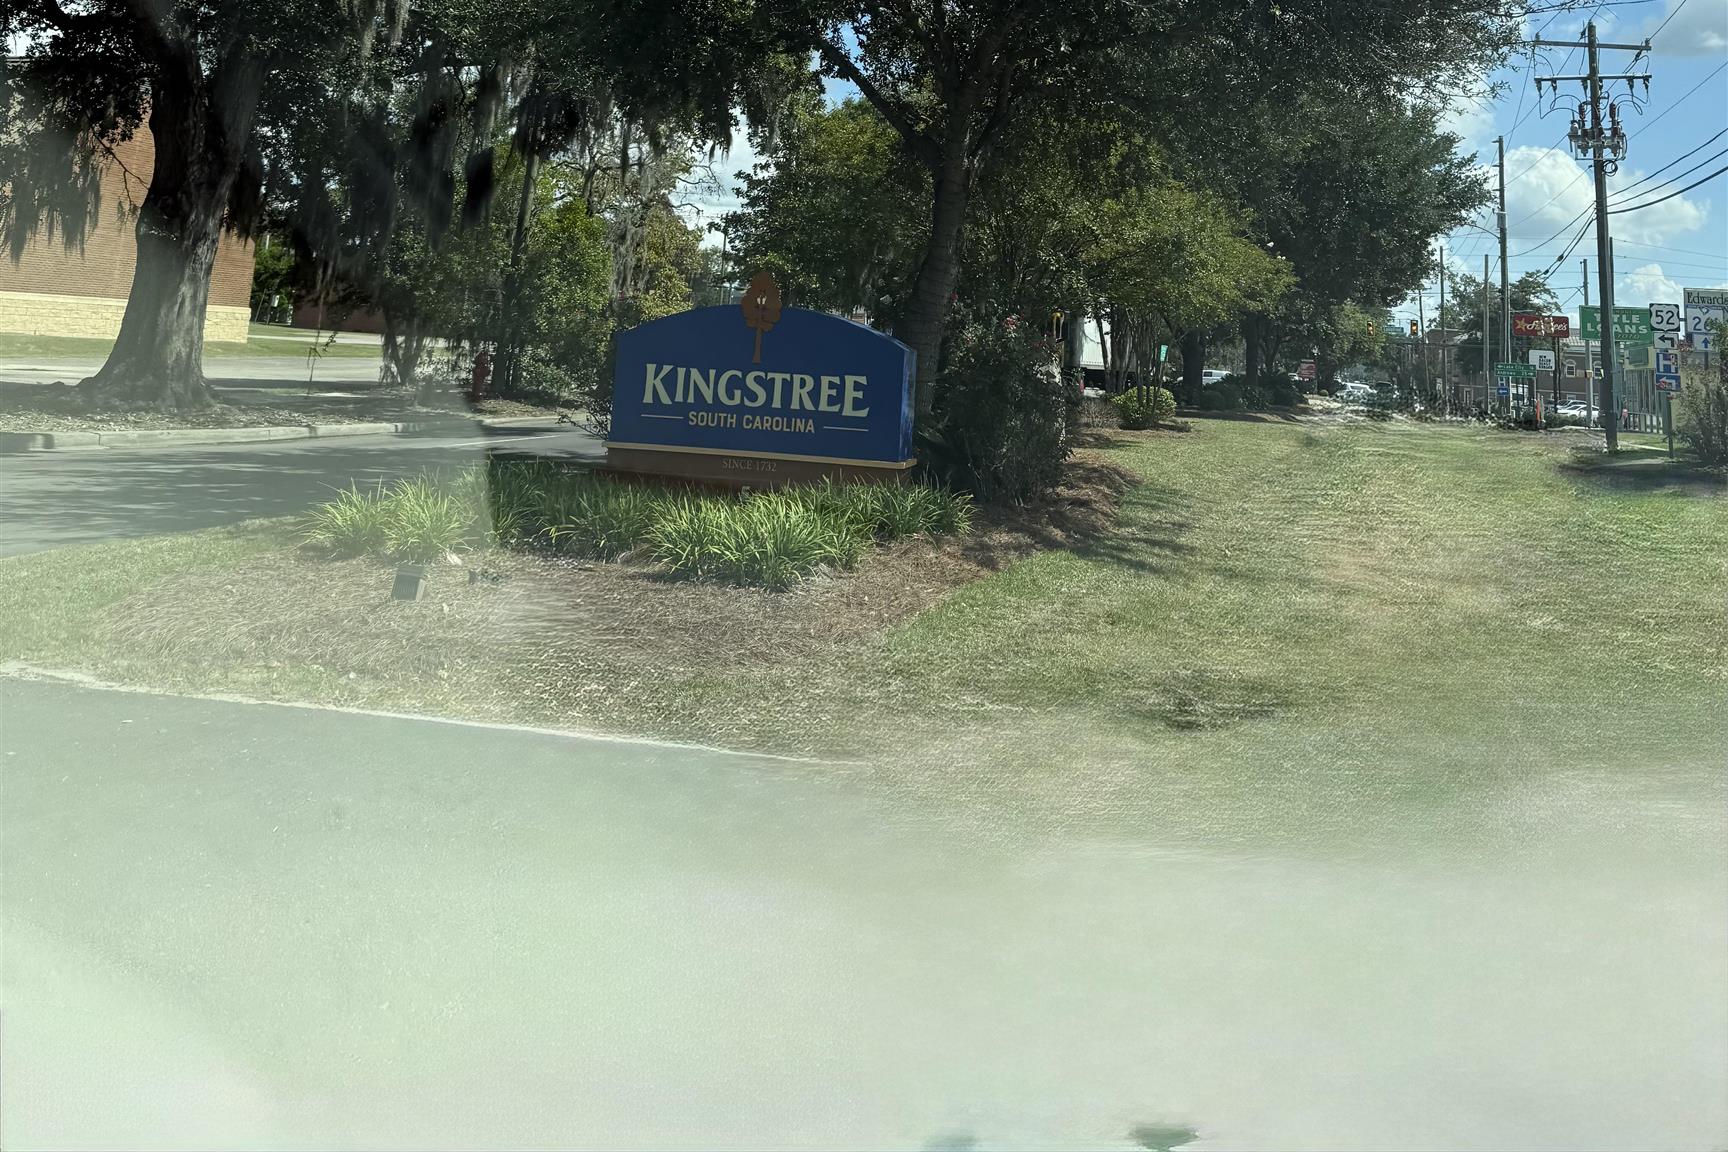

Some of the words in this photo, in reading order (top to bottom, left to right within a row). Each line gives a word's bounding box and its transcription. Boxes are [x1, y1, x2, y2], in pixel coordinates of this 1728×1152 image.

[1594, 313, 1640, 323] TTLE
[1656, 310, 1675, 325] 52
[642, 363, 870, 417] KINGSTREE
[688, 411, 737, 428] SOUTH
[742, 414, 815, 433] CAROLINA
[722, 459, 753, 469] SINCE
[755, 460, 777, 471] 1732
